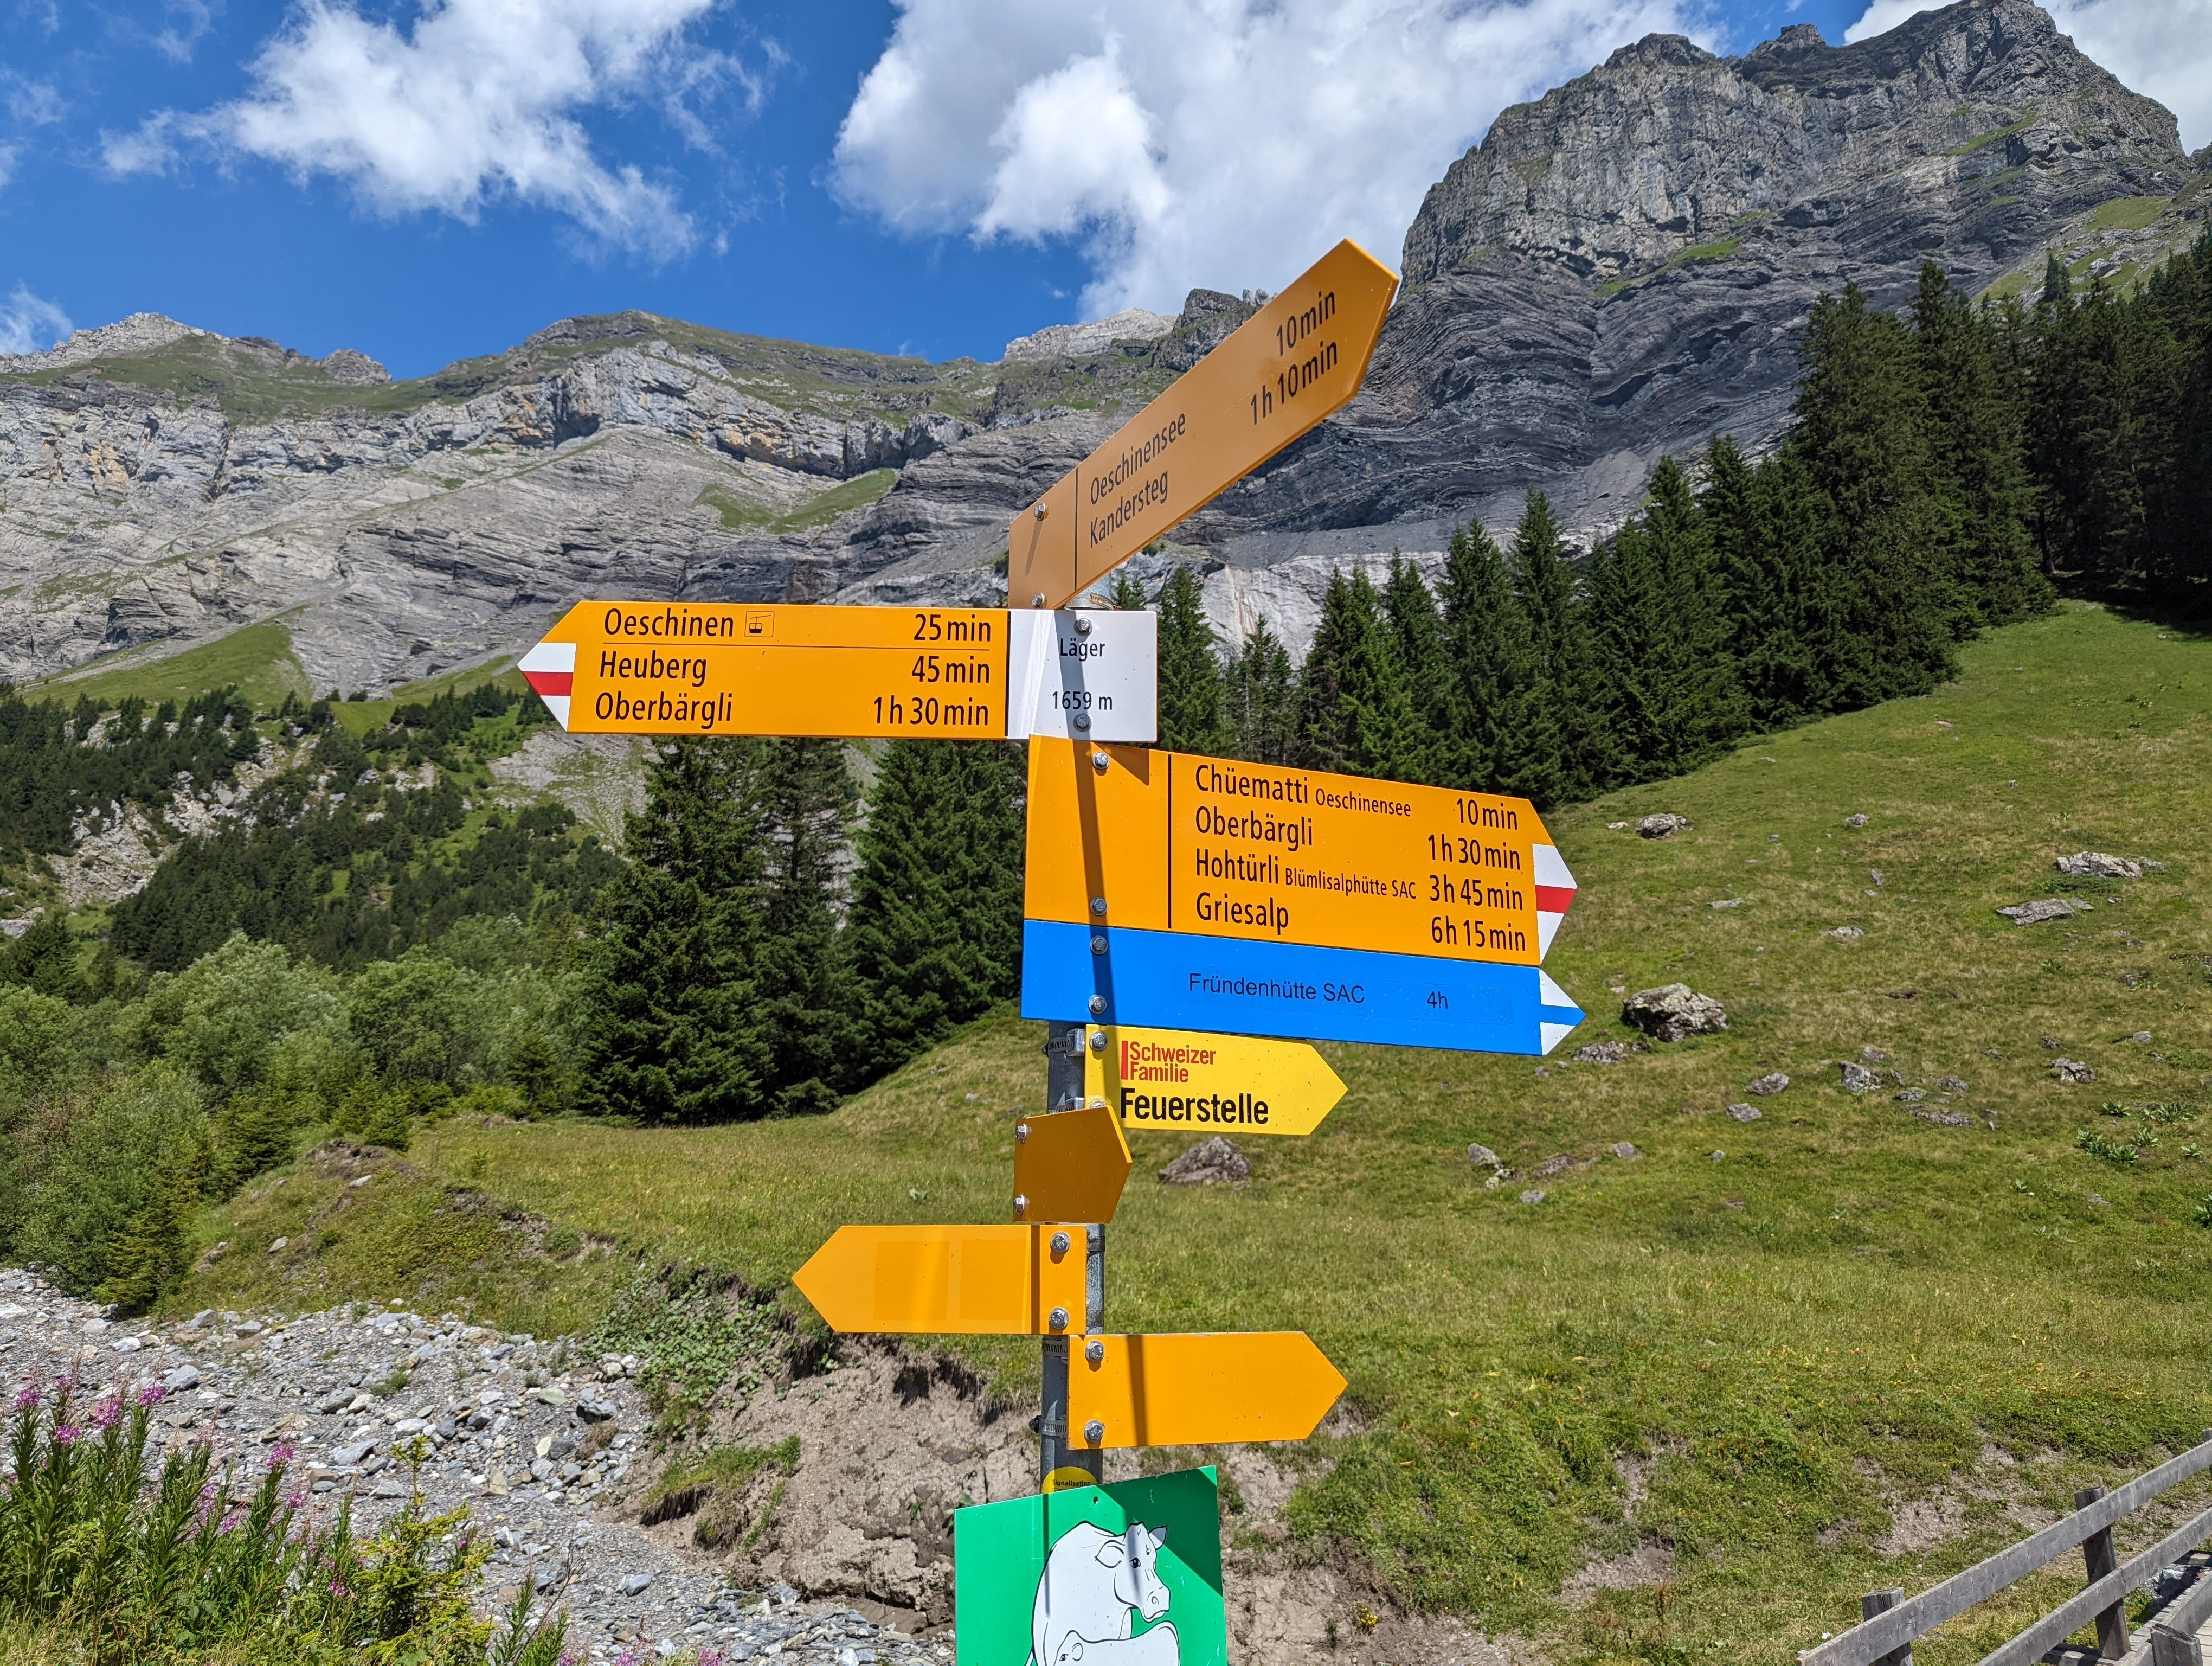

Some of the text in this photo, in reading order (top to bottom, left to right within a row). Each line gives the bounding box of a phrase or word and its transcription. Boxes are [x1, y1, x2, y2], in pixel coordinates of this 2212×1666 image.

[1090, 413, 1186, 505] Oeschinensee
[1090, 470, 1168, 549] Kandersteg
[605, 607, 734, 637] Oeschinen
[600, 649, 706, 688] Heuberg
[1060, 637, 1106, 662] Läger
[595, 690, 733, 731] Oberbärgli
[1052, 691, 1113, 710] 1659 m
[1195, 764, 1411, 817] Chüematti Oeschinensee
[1195, 805, 1313, 852] Oberbärgli
[1197, 848, 1416, 899] Hohtürli Blümlisalphütte SAC
[1196, 892, 1289, 936] Griesalp
[1189, 972, 1365, 1003] Fründenhütte SAC
[1426, 991, 1448, 1009] 4h
[1129, 1041, 1216, 1066] Schweizer
[1129, 1061, 1189, 1084] Familie
[1120, 1087, 1269, 1125] Feuerstelle
[1051, 1479, 1091, 1487] Signalisation
